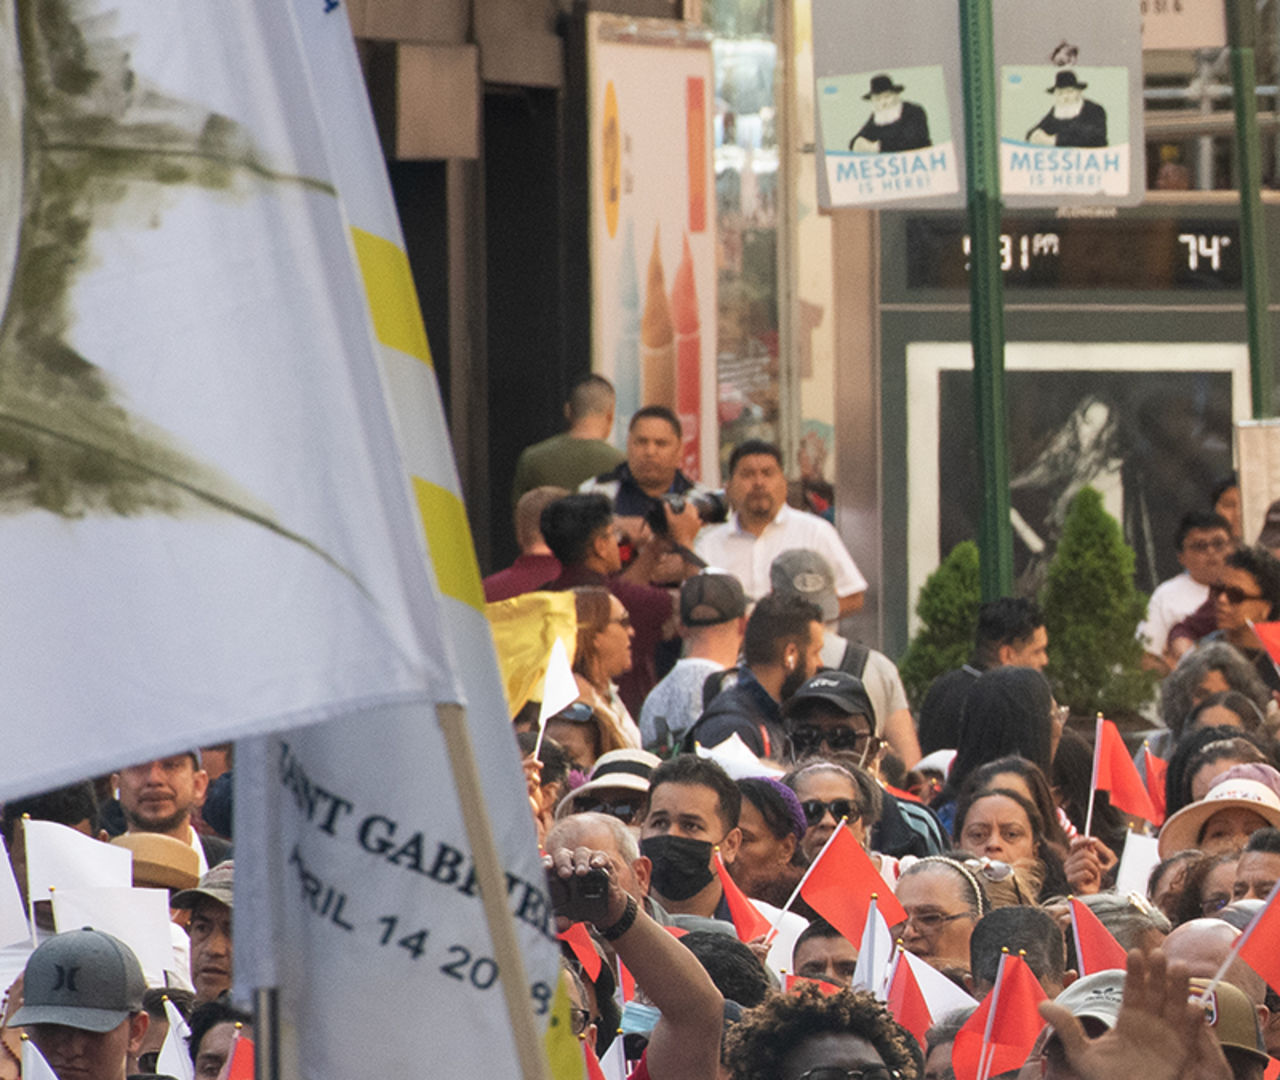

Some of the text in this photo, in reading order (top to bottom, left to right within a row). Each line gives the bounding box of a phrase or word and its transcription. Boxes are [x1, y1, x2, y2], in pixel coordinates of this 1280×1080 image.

[836, 153, 947, 183] MESSIAH
[1010, 151, 1120, 172] MESSIAH
[859, 174, 930, 195] IS HERE!
[1030, 173, 1101, 187] IS HERE!
[378, 915, 430, 961] 14
